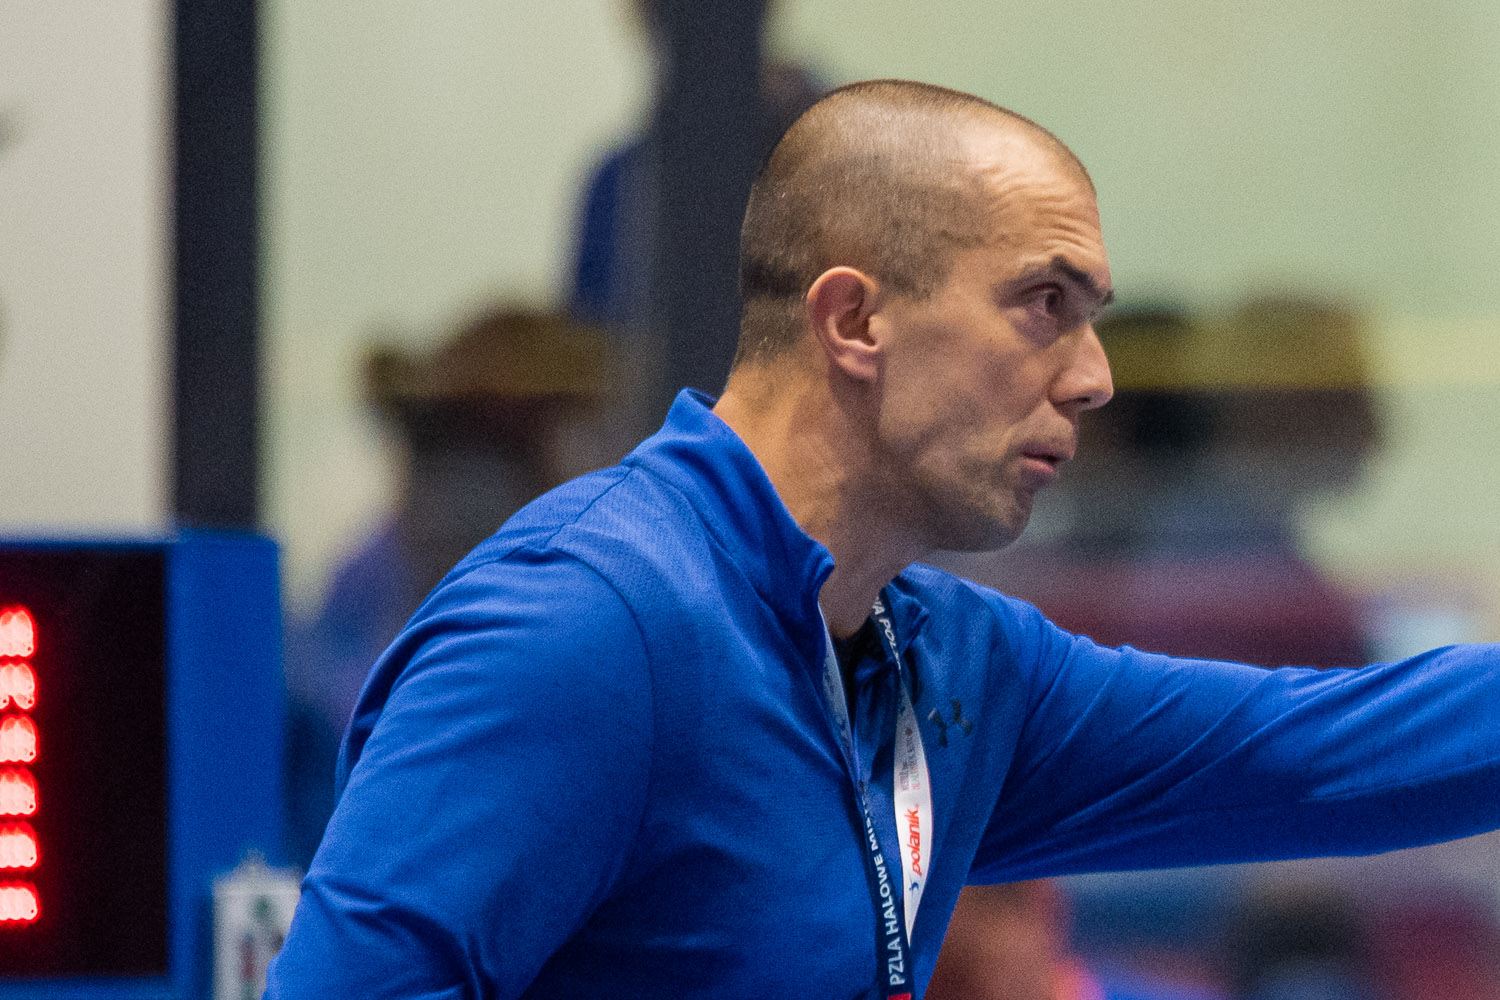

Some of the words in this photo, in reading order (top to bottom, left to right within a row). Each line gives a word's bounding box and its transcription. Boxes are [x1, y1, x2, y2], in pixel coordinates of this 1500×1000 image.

[904, 808, 922, 877] polanik
[873, 853, 900, 935] HALOWE
[887, 936, 906, 986] PZLA
